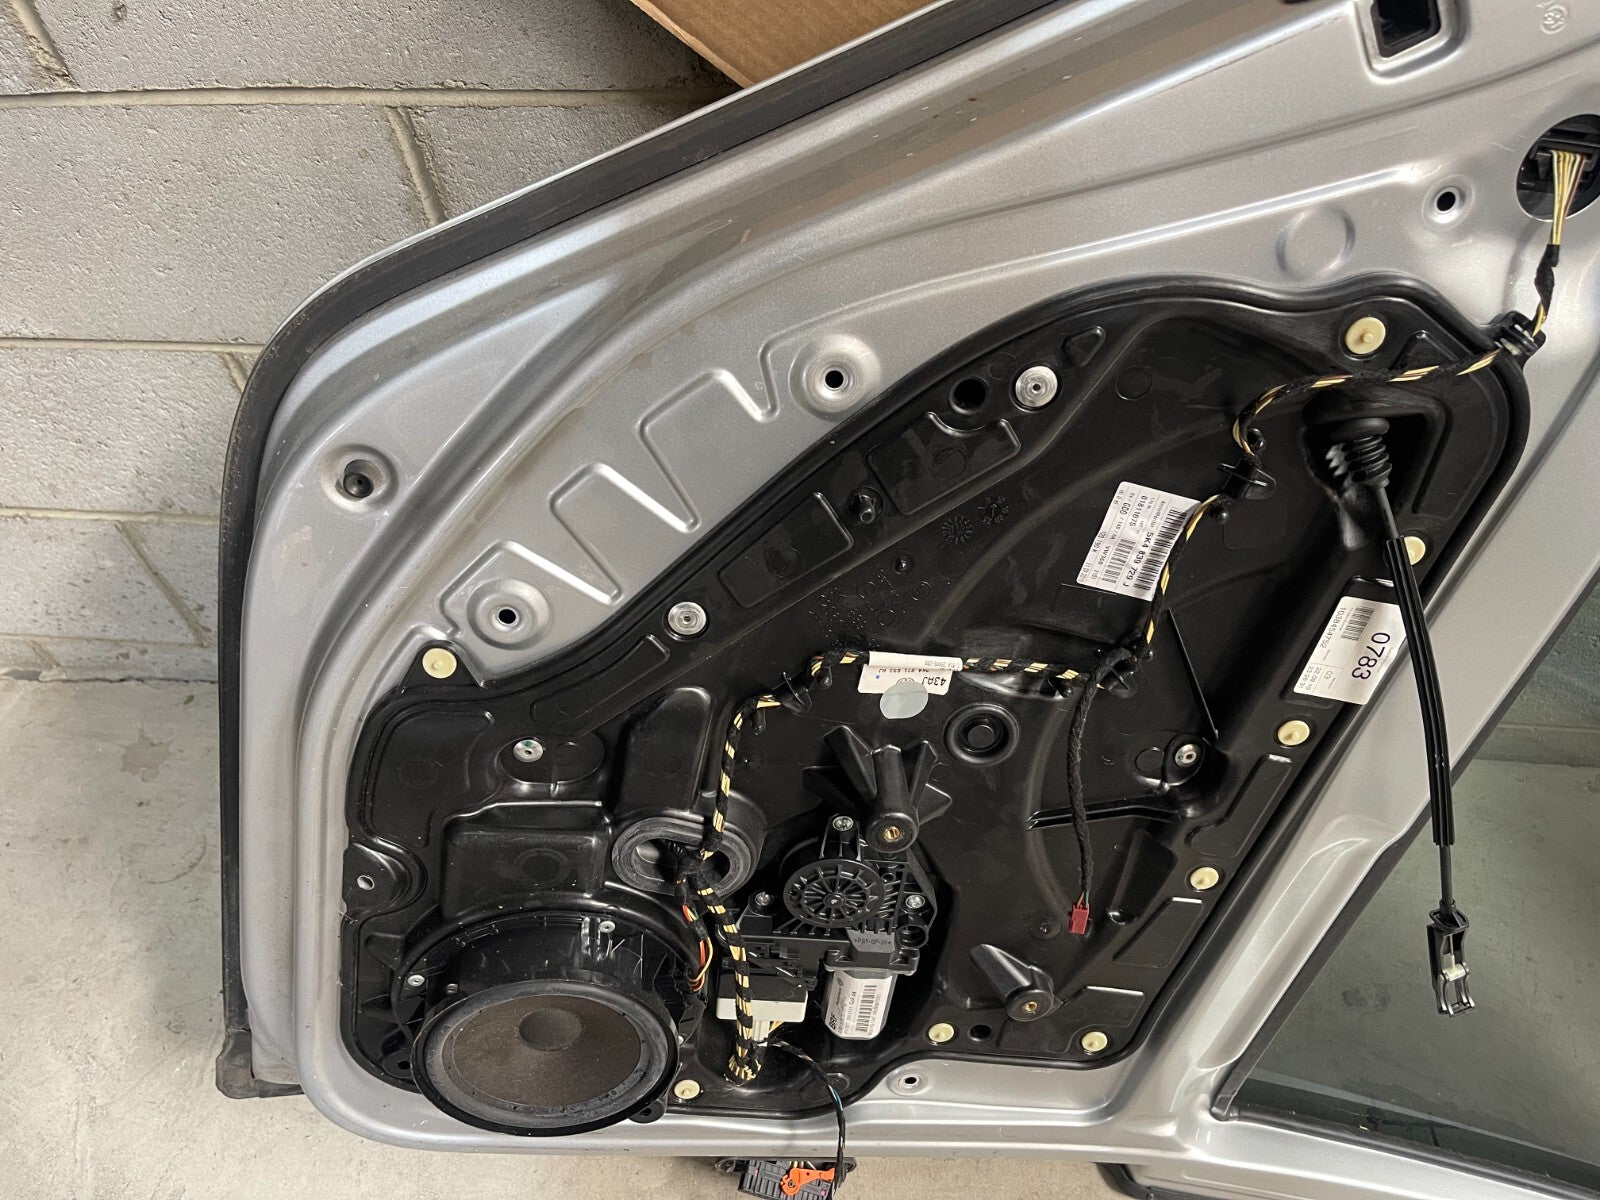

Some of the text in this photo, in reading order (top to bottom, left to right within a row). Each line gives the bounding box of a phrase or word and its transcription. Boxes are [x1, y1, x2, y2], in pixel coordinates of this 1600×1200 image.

[1142, 532, 1154, 548] 5K4
[1134, 551, 1146, 564] 839
[1126, 567, 1137, 580] 729
[1351, 632, 1391, 680] 0783
[921, 676, 947, 686] 43AJ
